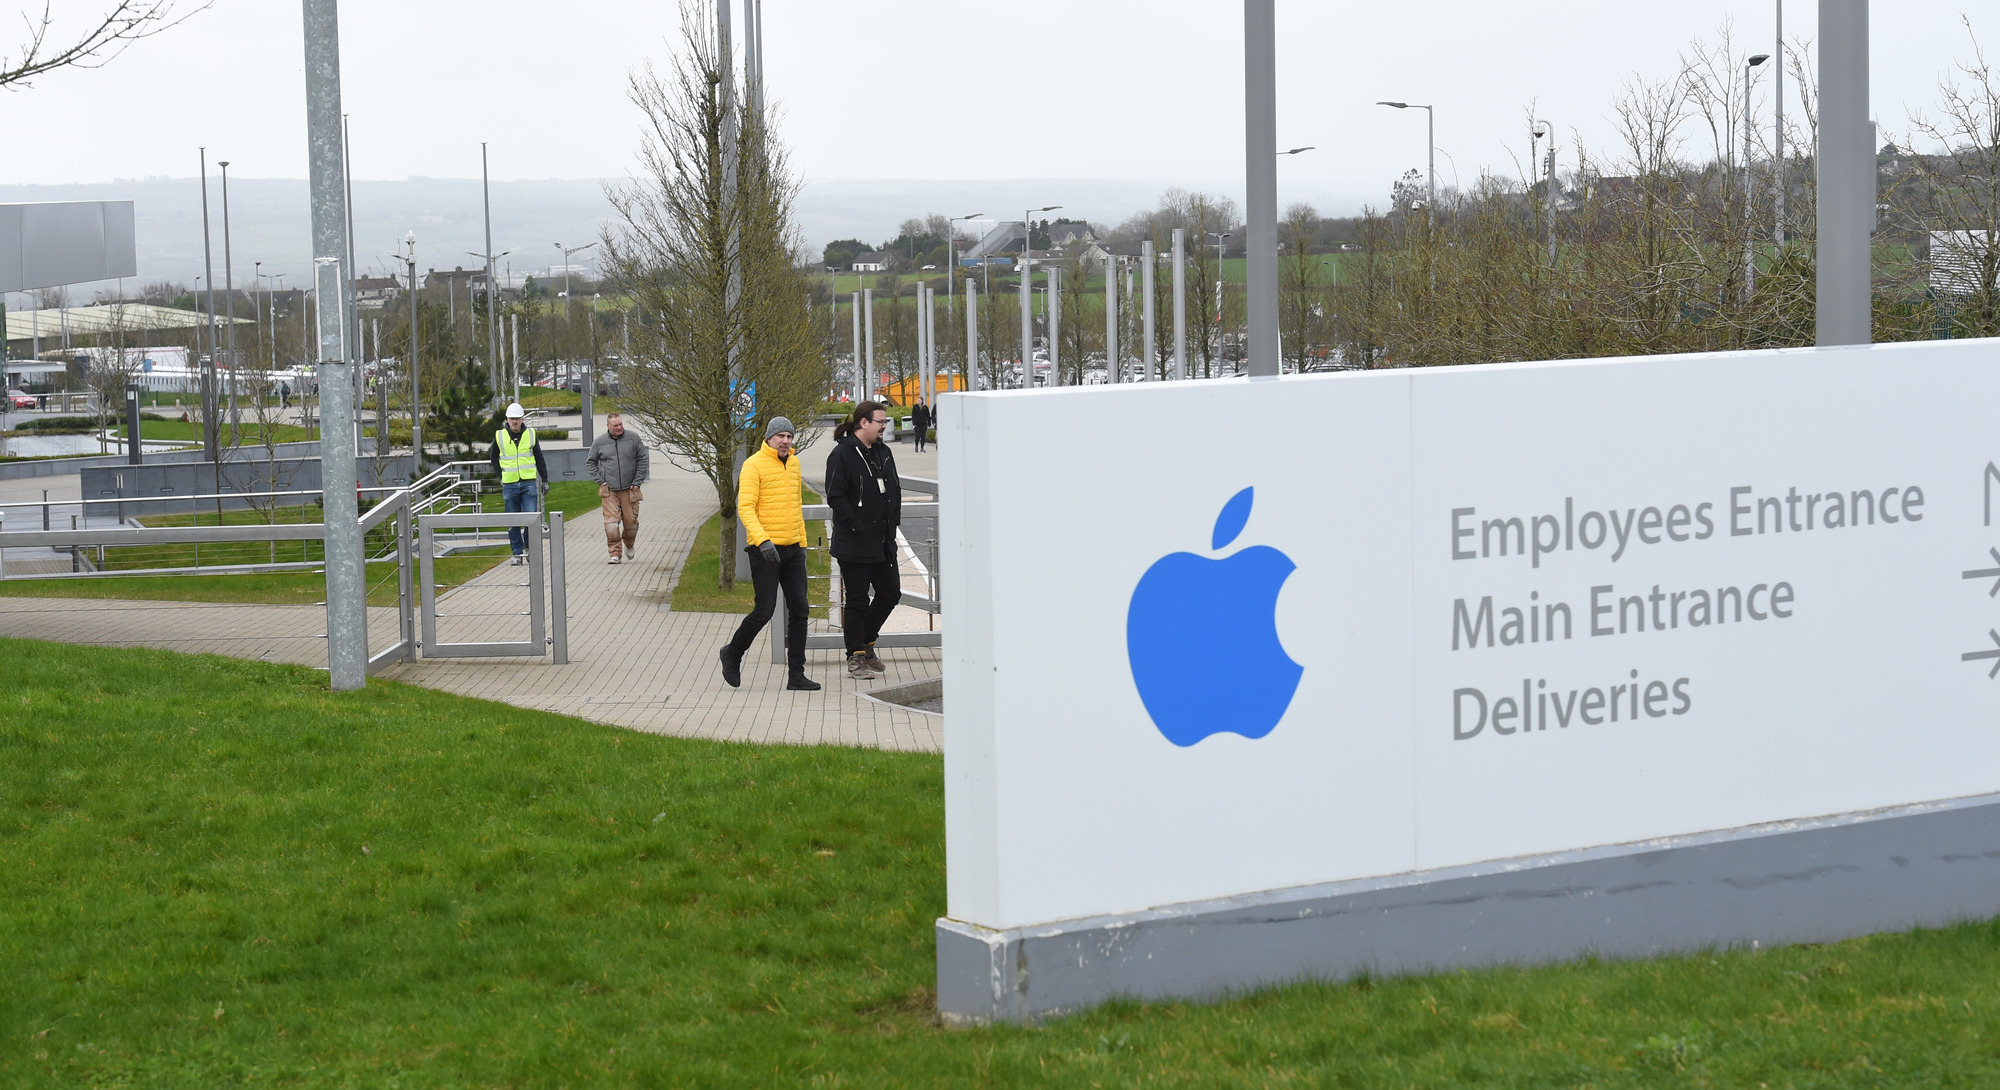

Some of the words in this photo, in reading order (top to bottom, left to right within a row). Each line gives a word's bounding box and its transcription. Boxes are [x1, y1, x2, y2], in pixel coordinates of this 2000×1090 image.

[1451, 496, 1714, 568] Employees
[1730, 484, 1924, 537] Entrance
[1451, 591, 1572, 650] Main
[1590, 581, 1795, 636] Entrance
[1453, 669, 1691, 740] Deliveries
